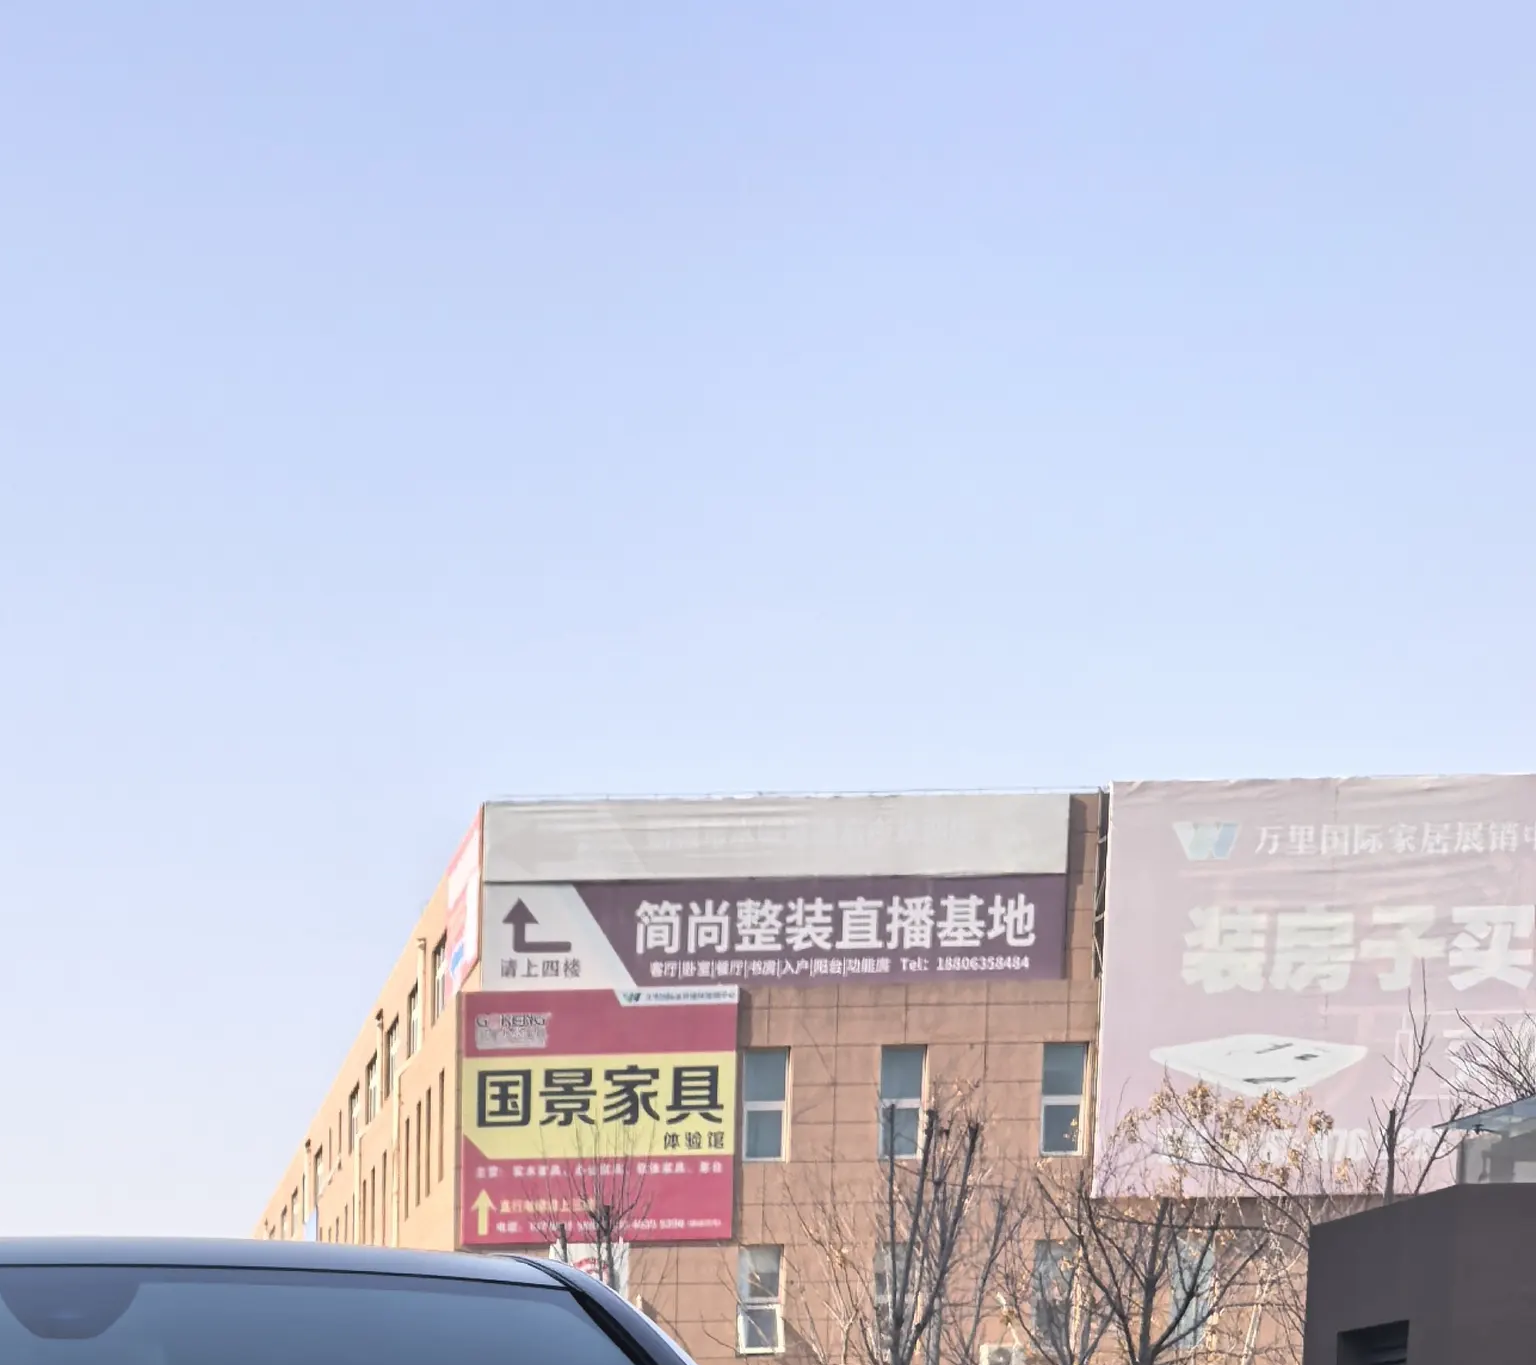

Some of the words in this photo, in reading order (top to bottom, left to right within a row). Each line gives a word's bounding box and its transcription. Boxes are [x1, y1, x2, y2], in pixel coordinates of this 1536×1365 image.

[635, 893, 1036, 954] 简尚整装直播基地
[1181, 905, 1535, 994] 装房子买
[500, 958, 581, 978] 请上四楼
[475, 1064, 725, 1128] 国景家具
[663, 1131, 725, 1150] 体验馆
